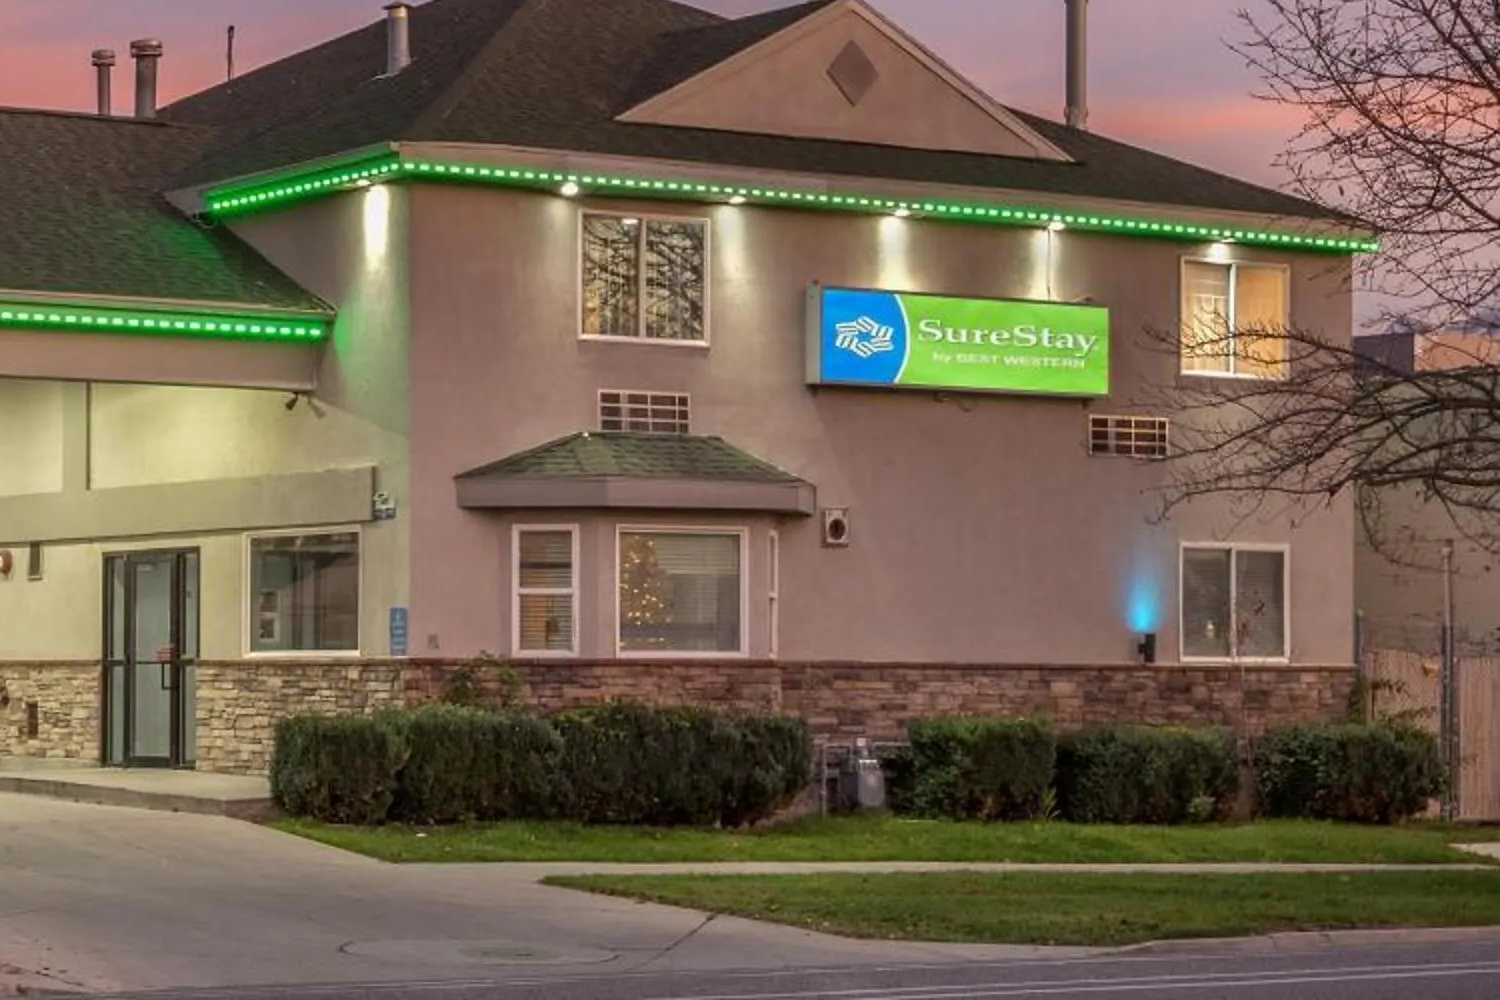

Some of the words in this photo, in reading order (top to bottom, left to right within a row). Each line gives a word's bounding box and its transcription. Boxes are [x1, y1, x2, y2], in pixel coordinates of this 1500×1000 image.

[918, 319, 1096, 357] SureStay
[932, 352, 951, 363] by
[956, 353, 997, 364] BEST
[1004, 355, 1085, 368] WESTERN
